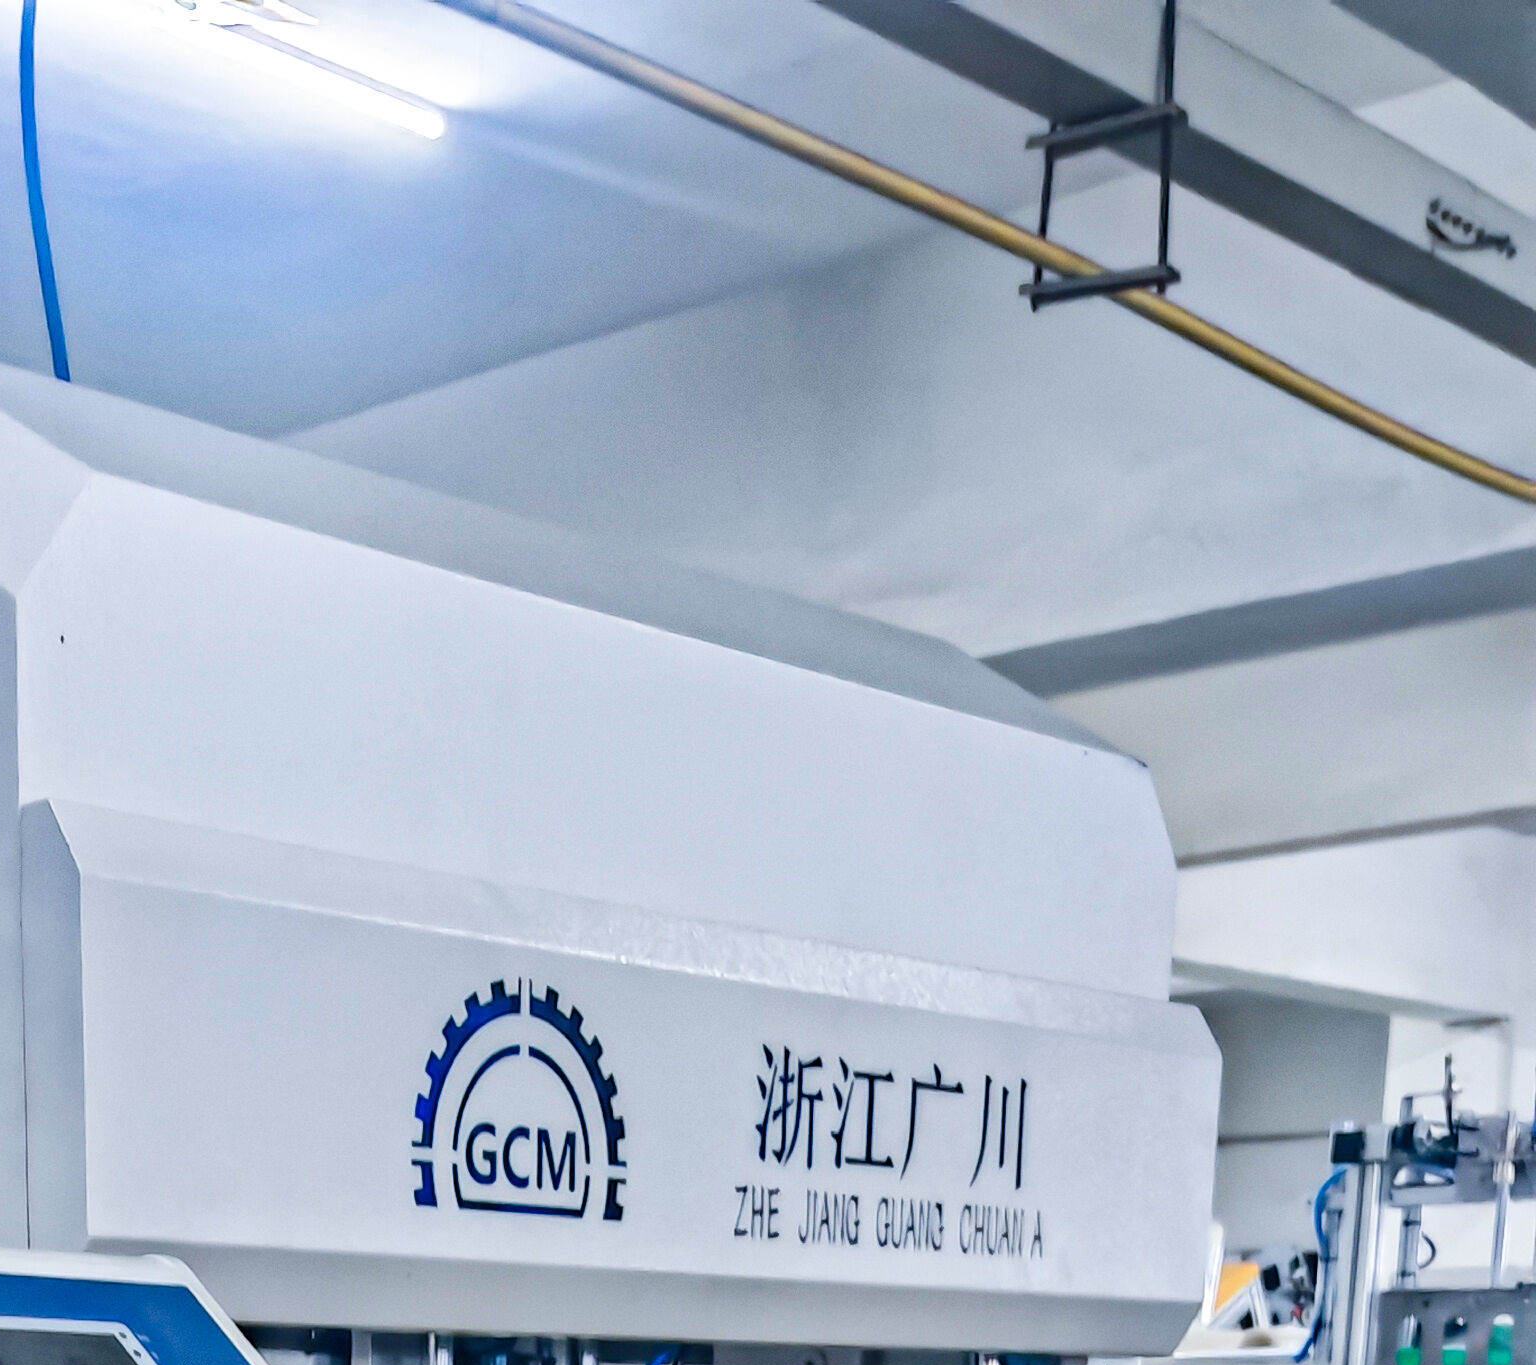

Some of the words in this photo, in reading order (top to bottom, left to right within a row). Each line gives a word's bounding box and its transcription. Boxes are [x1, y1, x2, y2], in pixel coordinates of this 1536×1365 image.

[755, 1043, 1028, 1190] 浙江广川
[465, 1121, 576, 1193] GCM
[734, 1184, 780, 1240] ZHE
[798, 1188, 860, 1245] JIANG
[876, 1196, 944, 1251] GUANG
